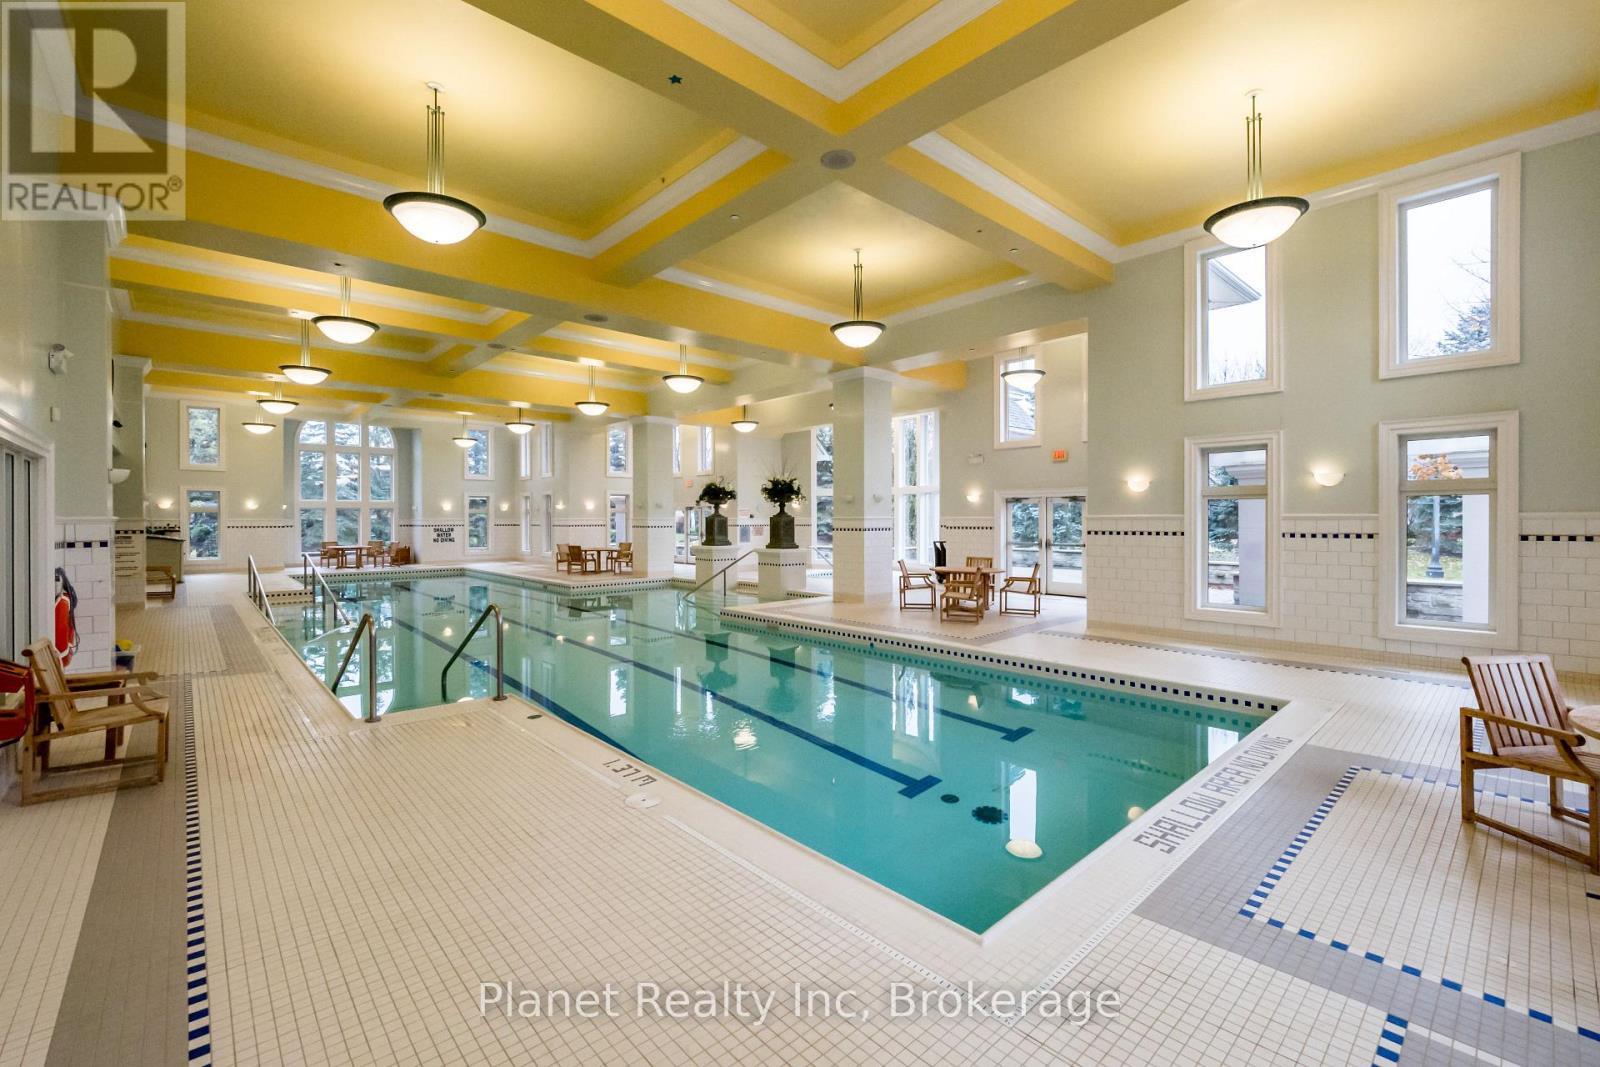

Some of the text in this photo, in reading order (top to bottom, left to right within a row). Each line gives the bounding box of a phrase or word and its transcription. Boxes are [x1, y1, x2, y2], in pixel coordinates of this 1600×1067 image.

[1133, 791, 1227, 854] SHALLOW
[1200, 767, 1256, 797] AREA
[1243, 734, 1293, 762] DIVING
